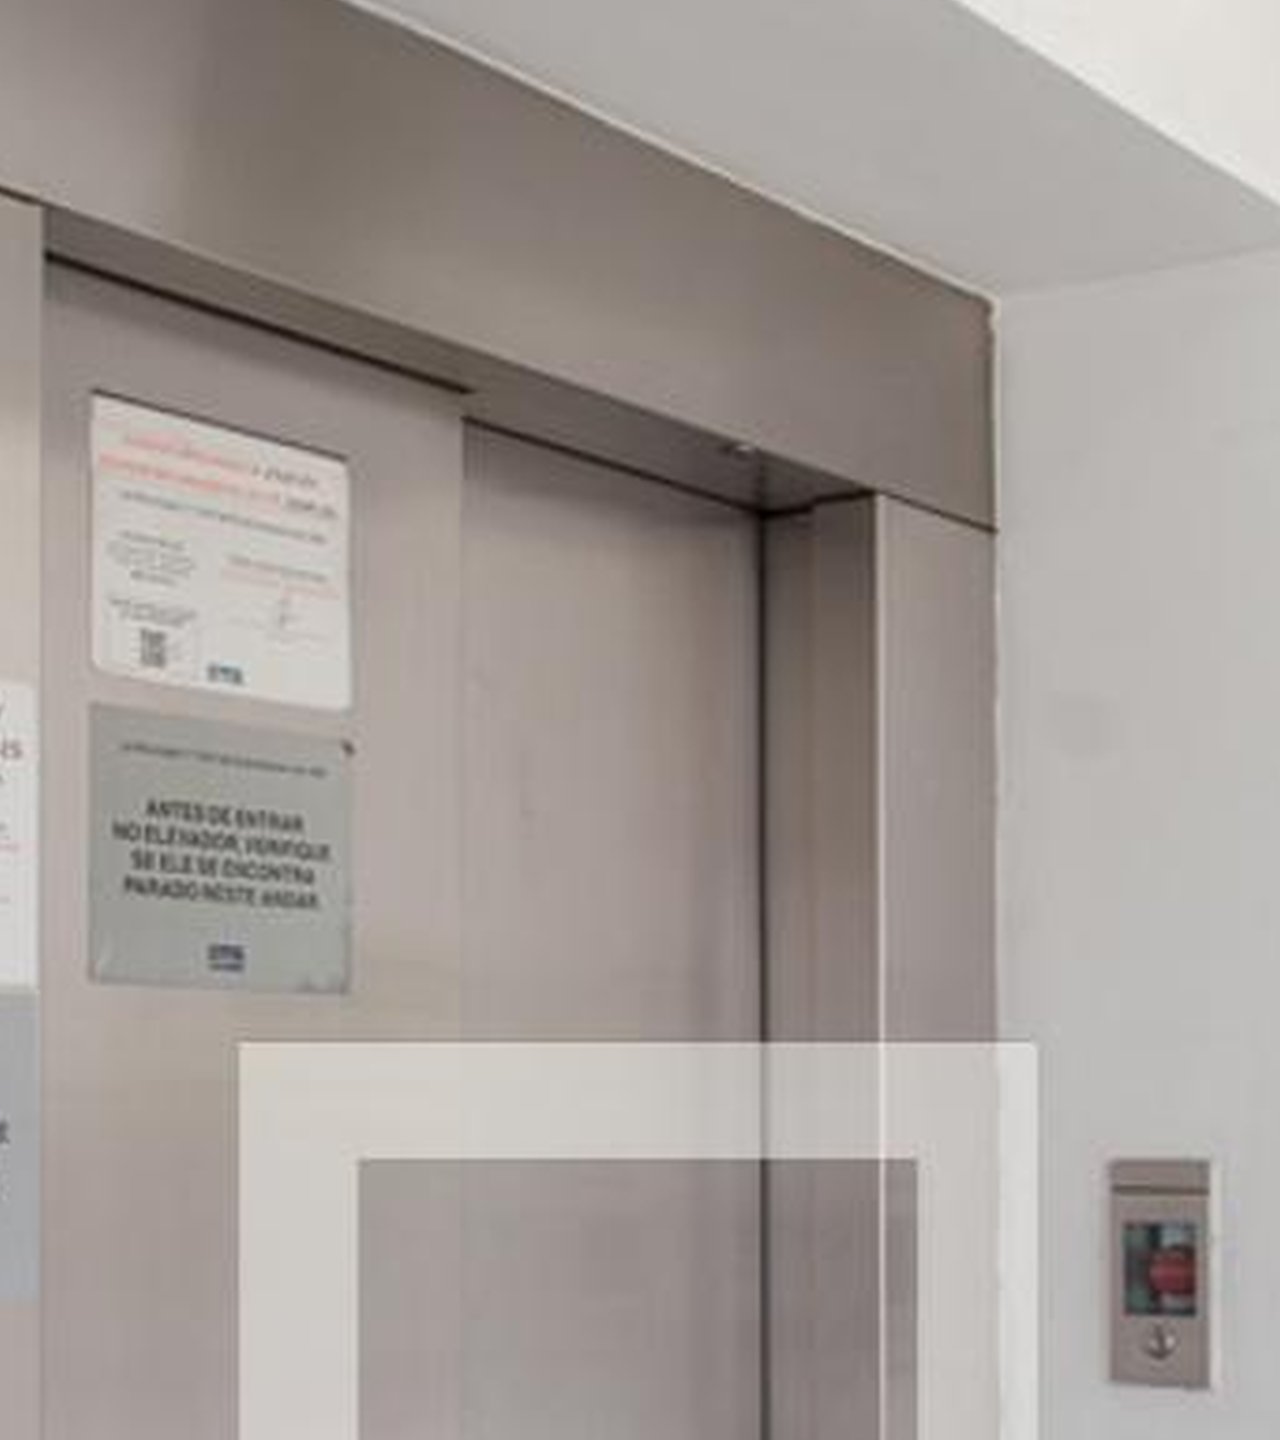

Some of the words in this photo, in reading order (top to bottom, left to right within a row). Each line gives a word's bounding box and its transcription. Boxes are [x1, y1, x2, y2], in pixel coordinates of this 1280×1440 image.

[112, 821, 141, 842] NO
[146, 800, 204, 823] ANTES
[208, 806, 231, 826] DE
[235, 809, 304, 833] ENTRAR
[130, 848, 156, 870] SE
[160, 854, 193, 875] ELE
[198, 856, 218, 877] SE
[222, 859, 315, 885] ENCONTRA
[124, 875, 198, 900] PARADO
[203, 883, 257, 906] NESTE
